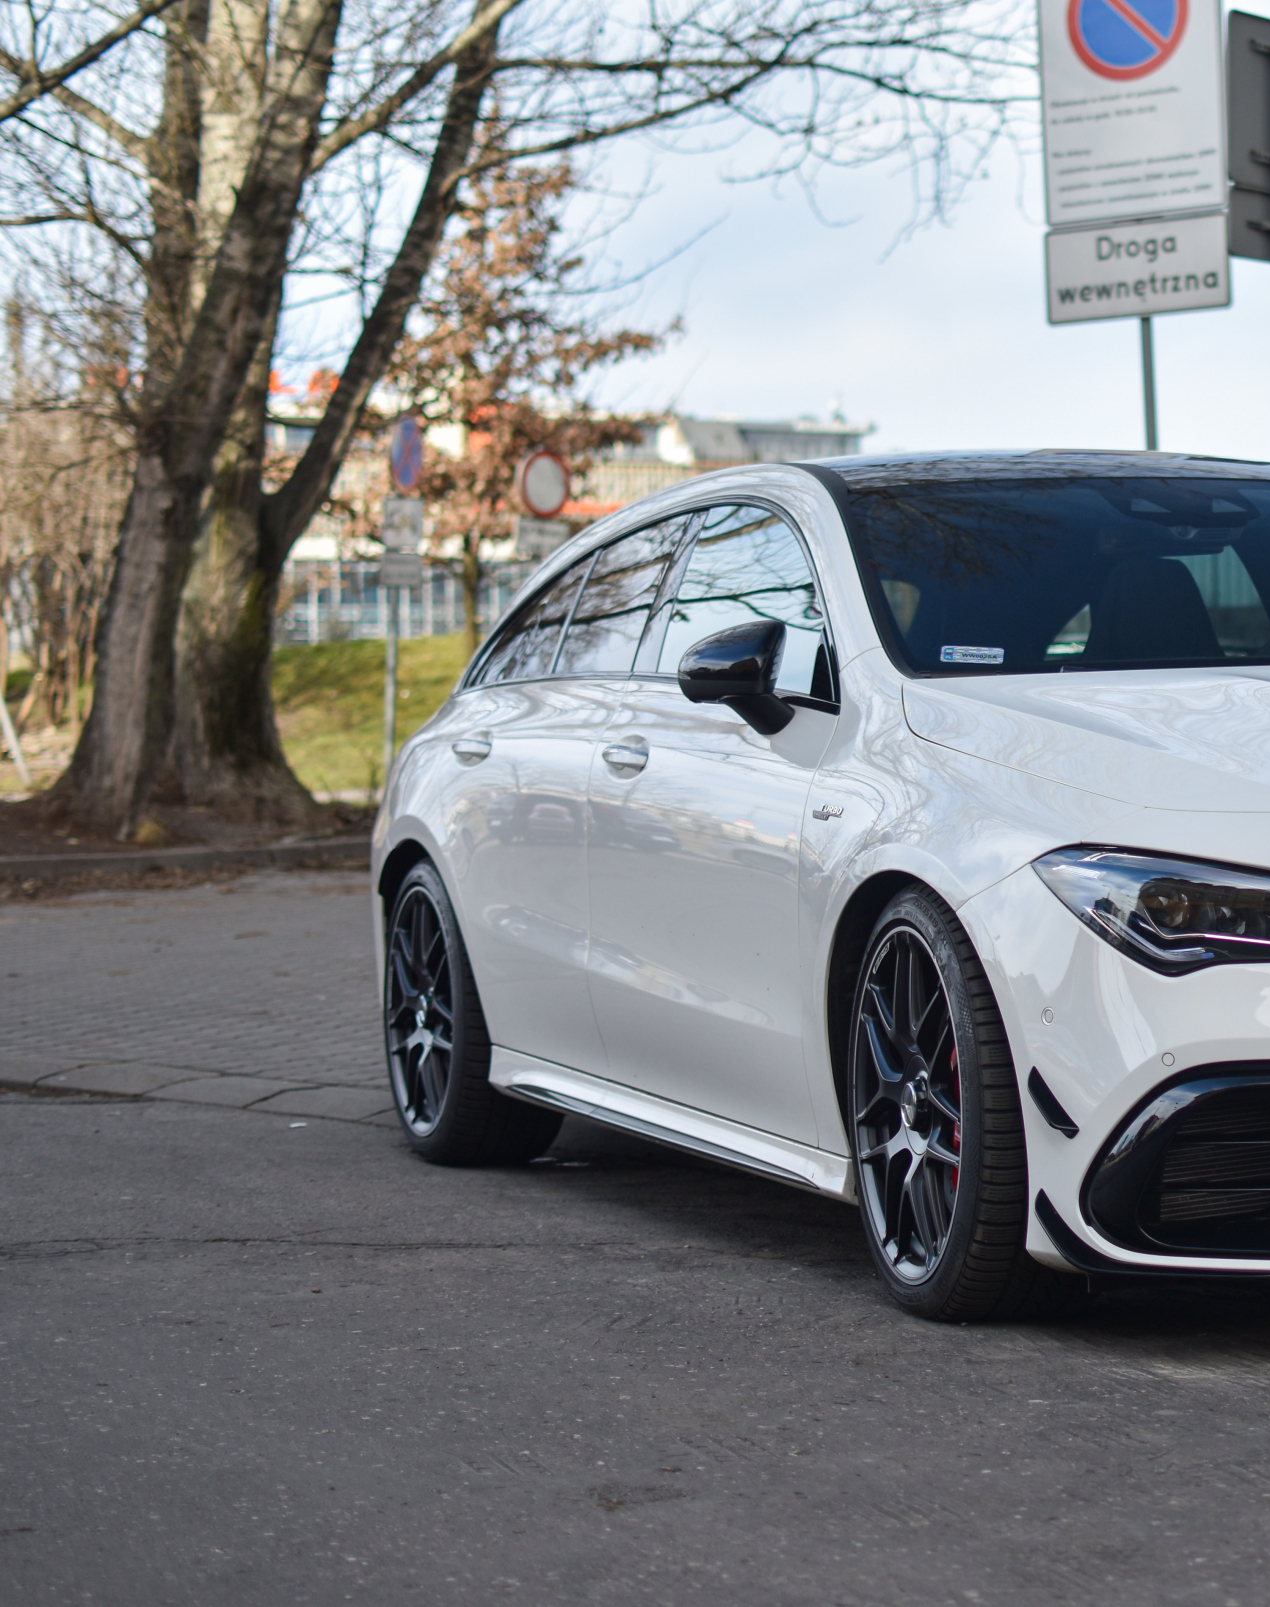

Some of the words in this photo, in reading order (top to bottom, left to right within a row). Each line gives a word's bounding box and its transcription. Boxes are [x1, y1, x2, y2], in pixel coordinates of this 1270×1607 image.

[1096, 236, 1177, 263] Droga
[1057, 271, 1219, 304] wewnętrzna
[820, 803, 844, 815] TURBO
